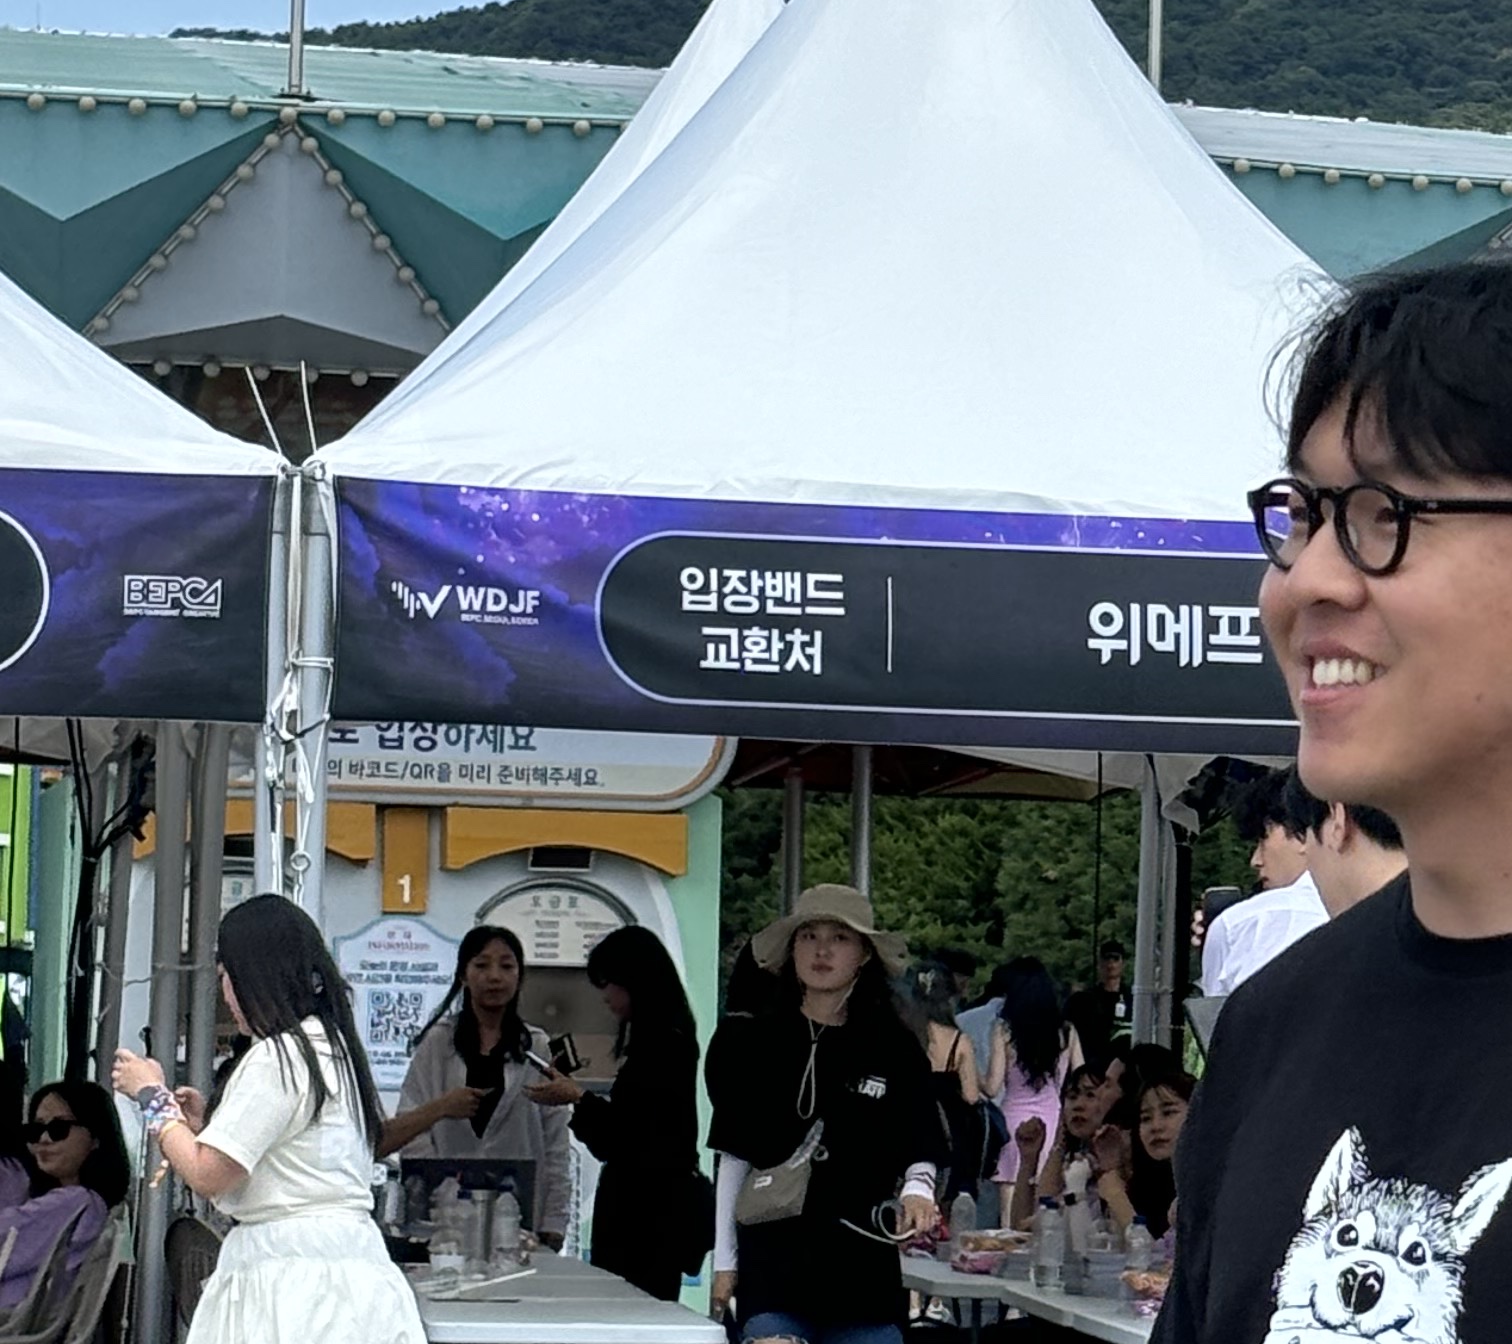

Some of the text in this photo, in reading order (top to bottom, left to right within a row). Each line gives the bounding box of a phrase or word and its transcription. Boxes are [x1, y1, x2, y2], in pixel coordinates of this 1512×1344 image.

[456, 585, 540, 614] WDJF
[679, 566, 846, 616] 입장밴드
[699, 626, 822, 675] 교환처
[1087, 601, 1263, 668] 위메프
[458, 763, 491, 784] 미리
[397, 873, 412, 904] 1
